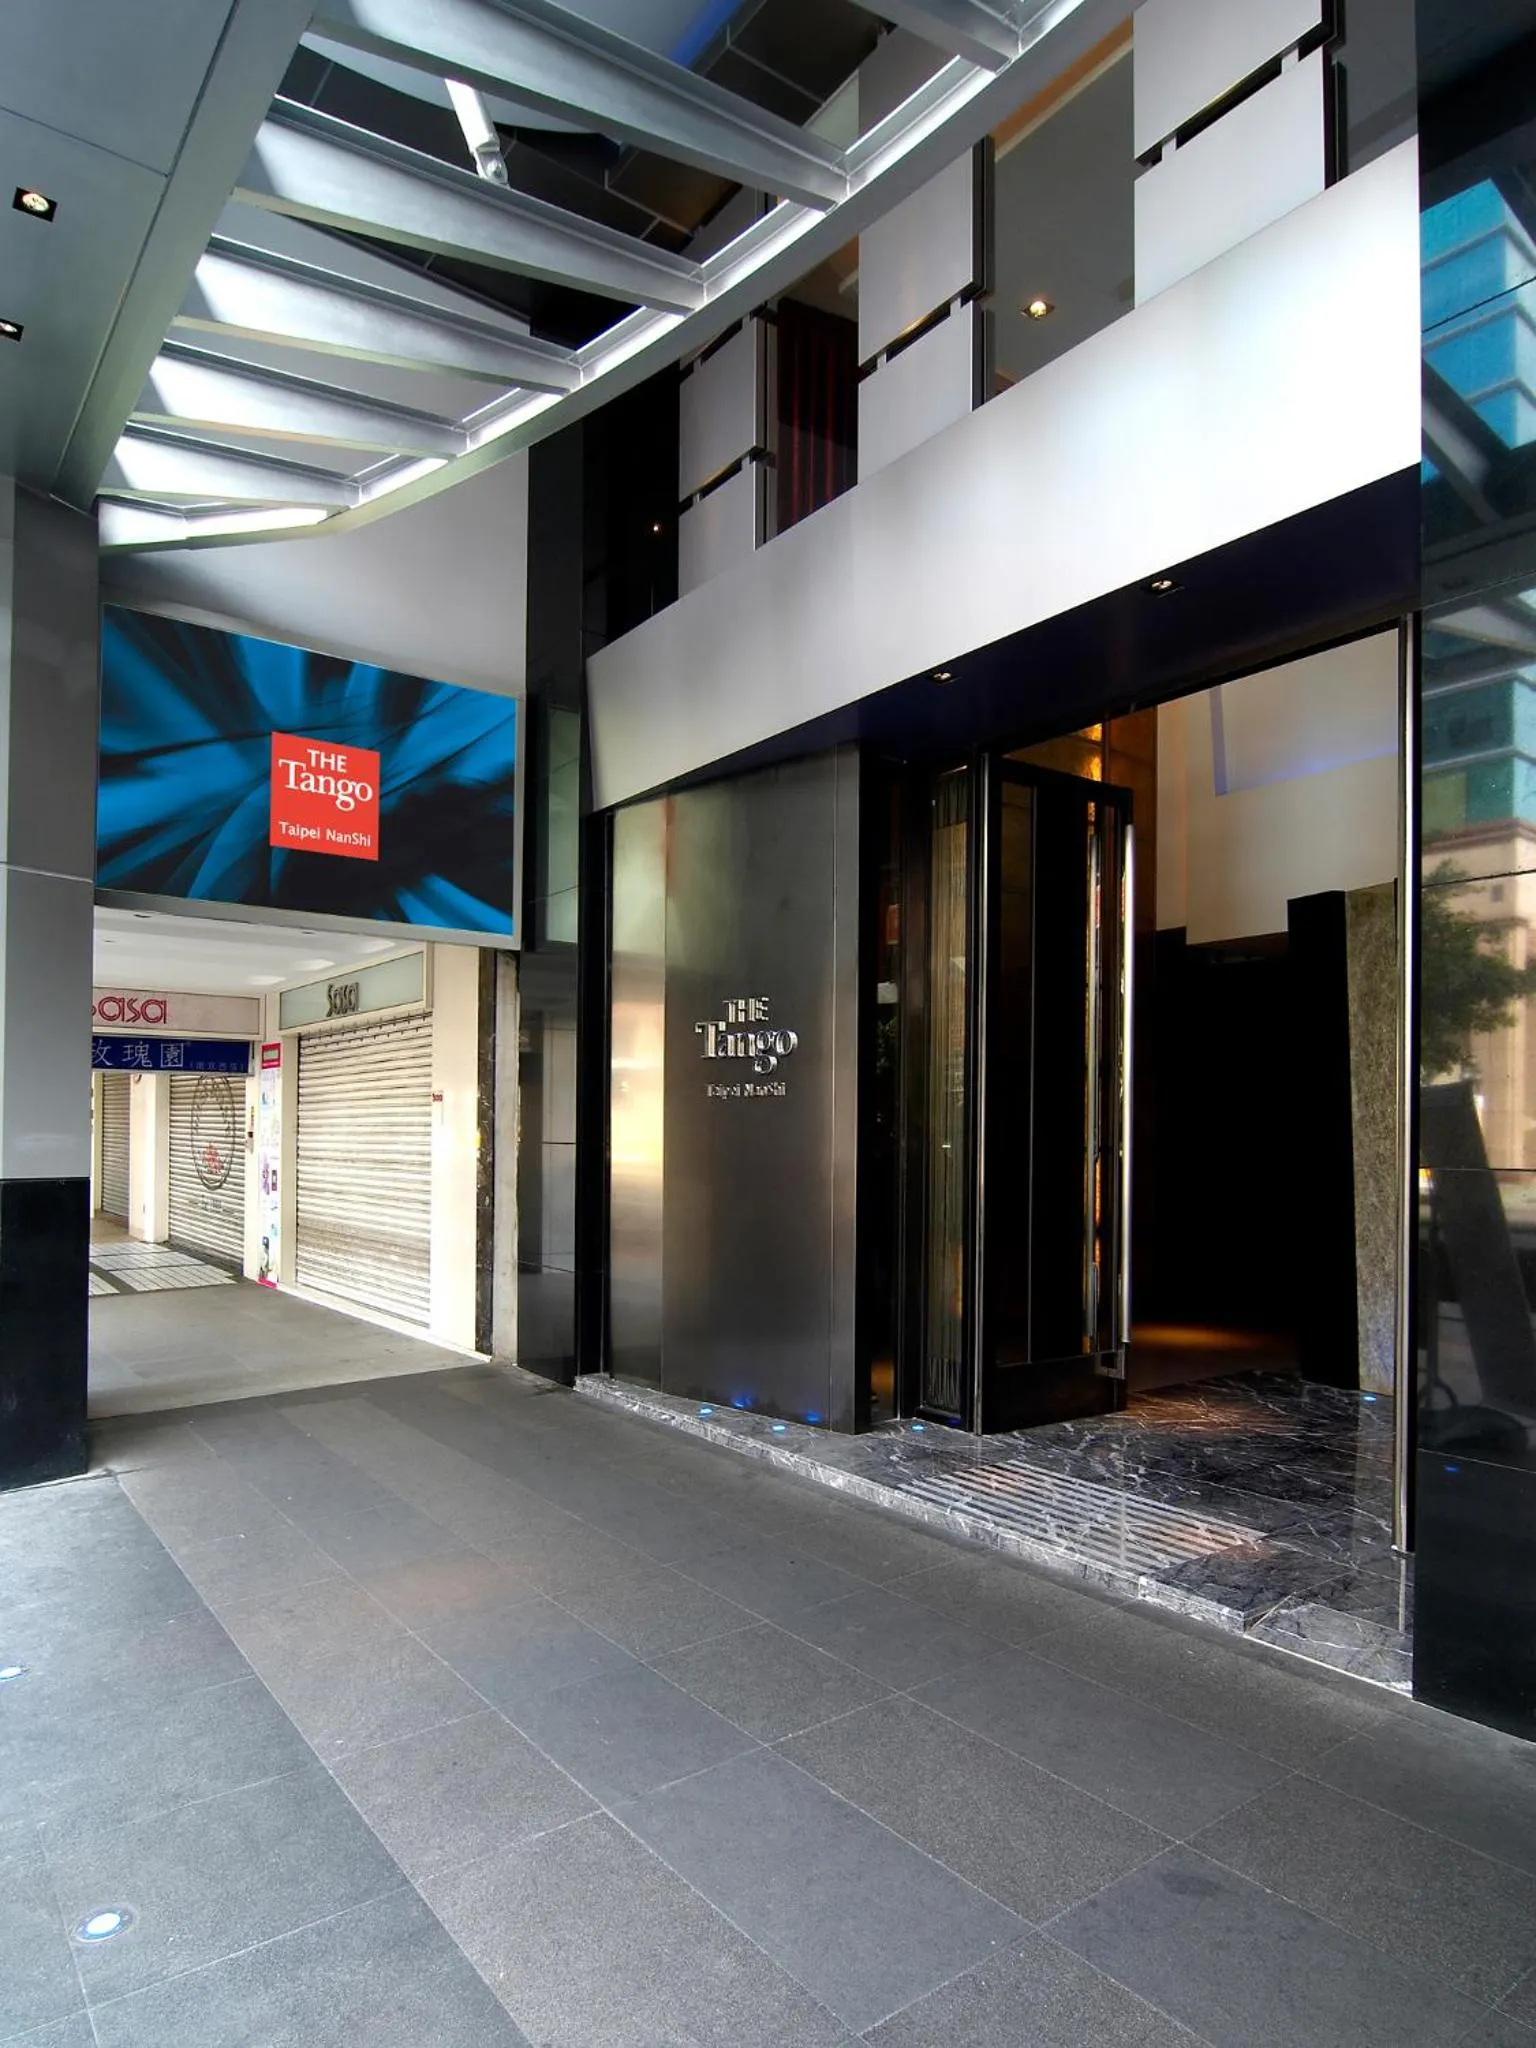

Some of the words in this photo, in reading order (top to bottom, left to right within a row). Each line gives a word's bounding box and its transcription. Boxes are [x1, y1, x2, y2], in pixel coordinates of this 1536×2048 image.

[307, 748, 347, 773] THE
[278, 759, 373, 812] Tango
[278, 821, 320, 840] Taipei
[326, 828, 371, 847] NanShi
[92, 996, 167, 1024] asa
[722, 997, 769, 1023] THE
[695, 1020, 798, 1074] Tango
